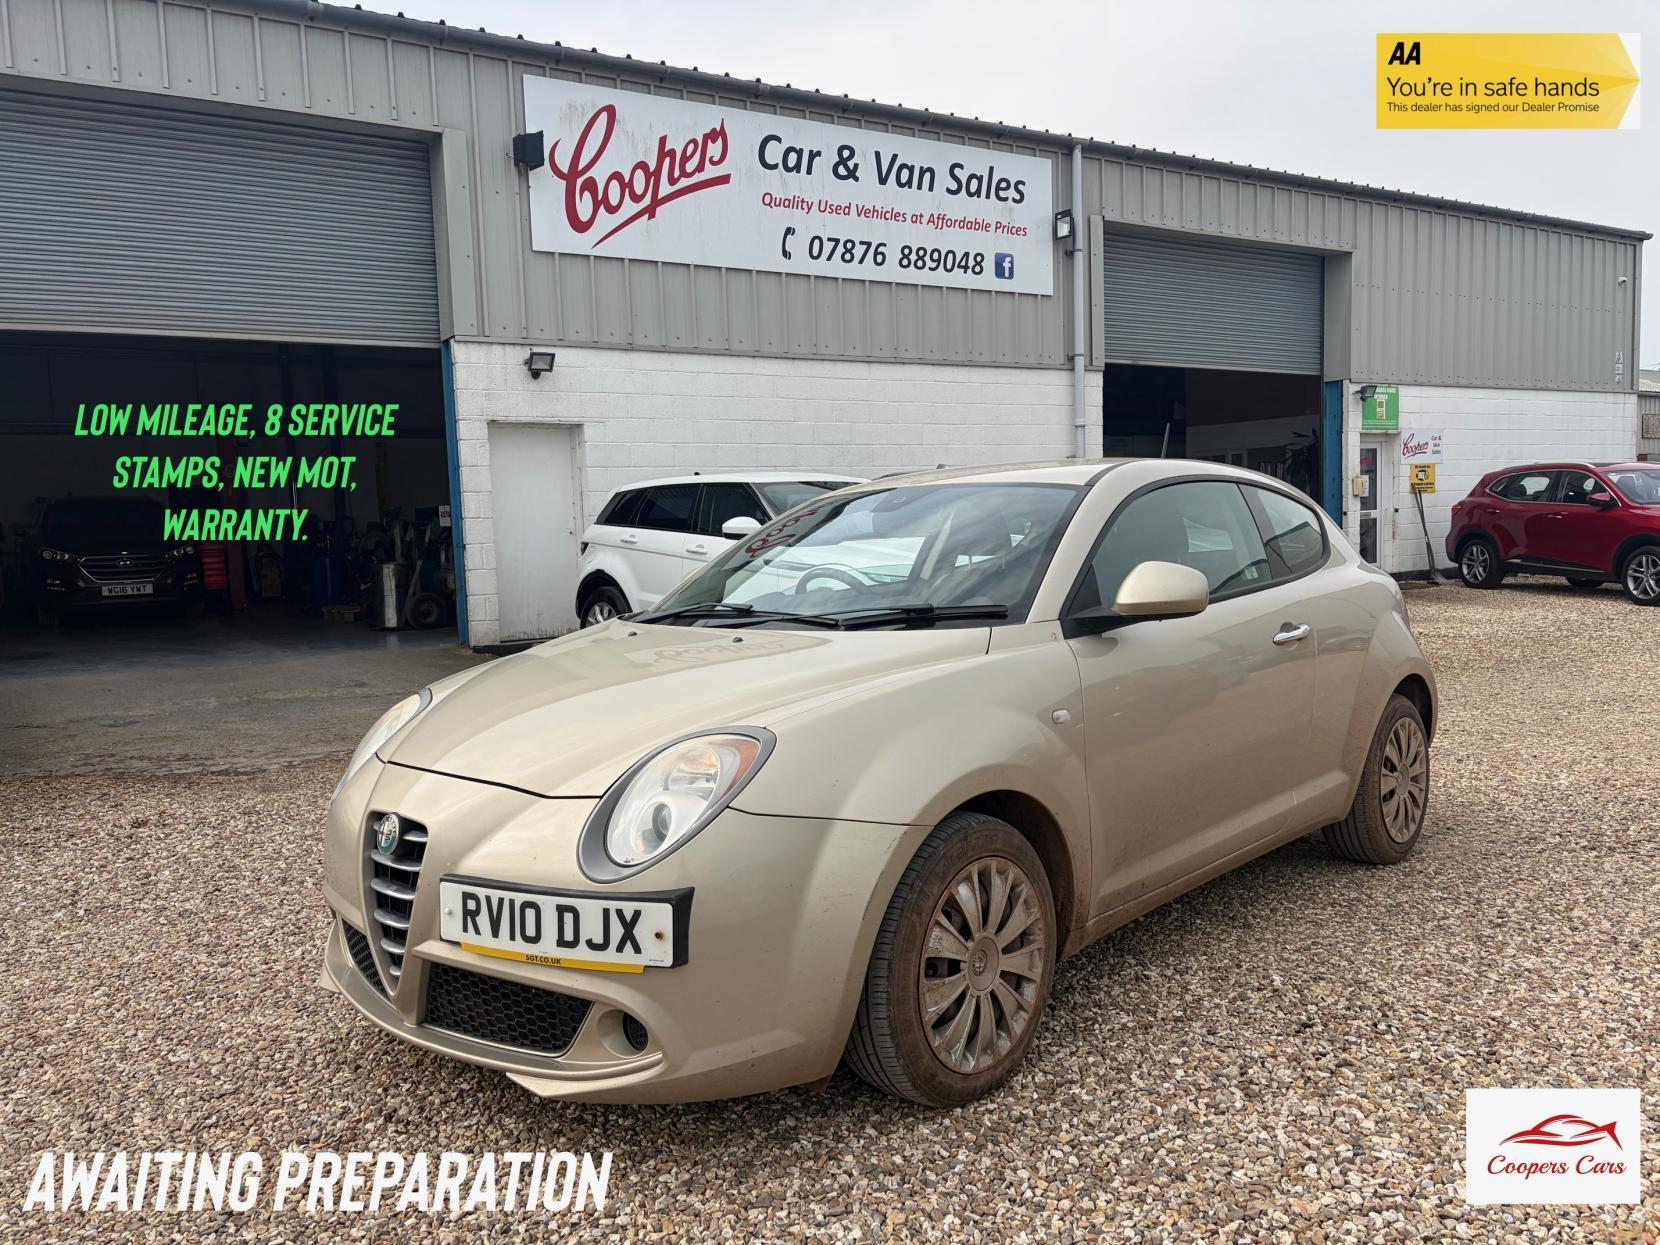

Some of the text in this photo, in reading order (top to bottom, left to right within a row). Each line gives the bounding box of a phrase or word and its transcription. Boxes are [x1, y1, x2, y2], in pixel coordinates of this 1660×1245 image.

[549, 104, 731, 247] Coopers
[758, 134, 1026, 204] Car & Van Sales
[761, 192, 1028, 237] Quality Used Vehicles at Affordable Prices
[808, 235, 985, 276] 07876 889048
[461, 891, 642, 955] RV10 DJX
[525, 954, 562, 965] SGT.CO.UK
